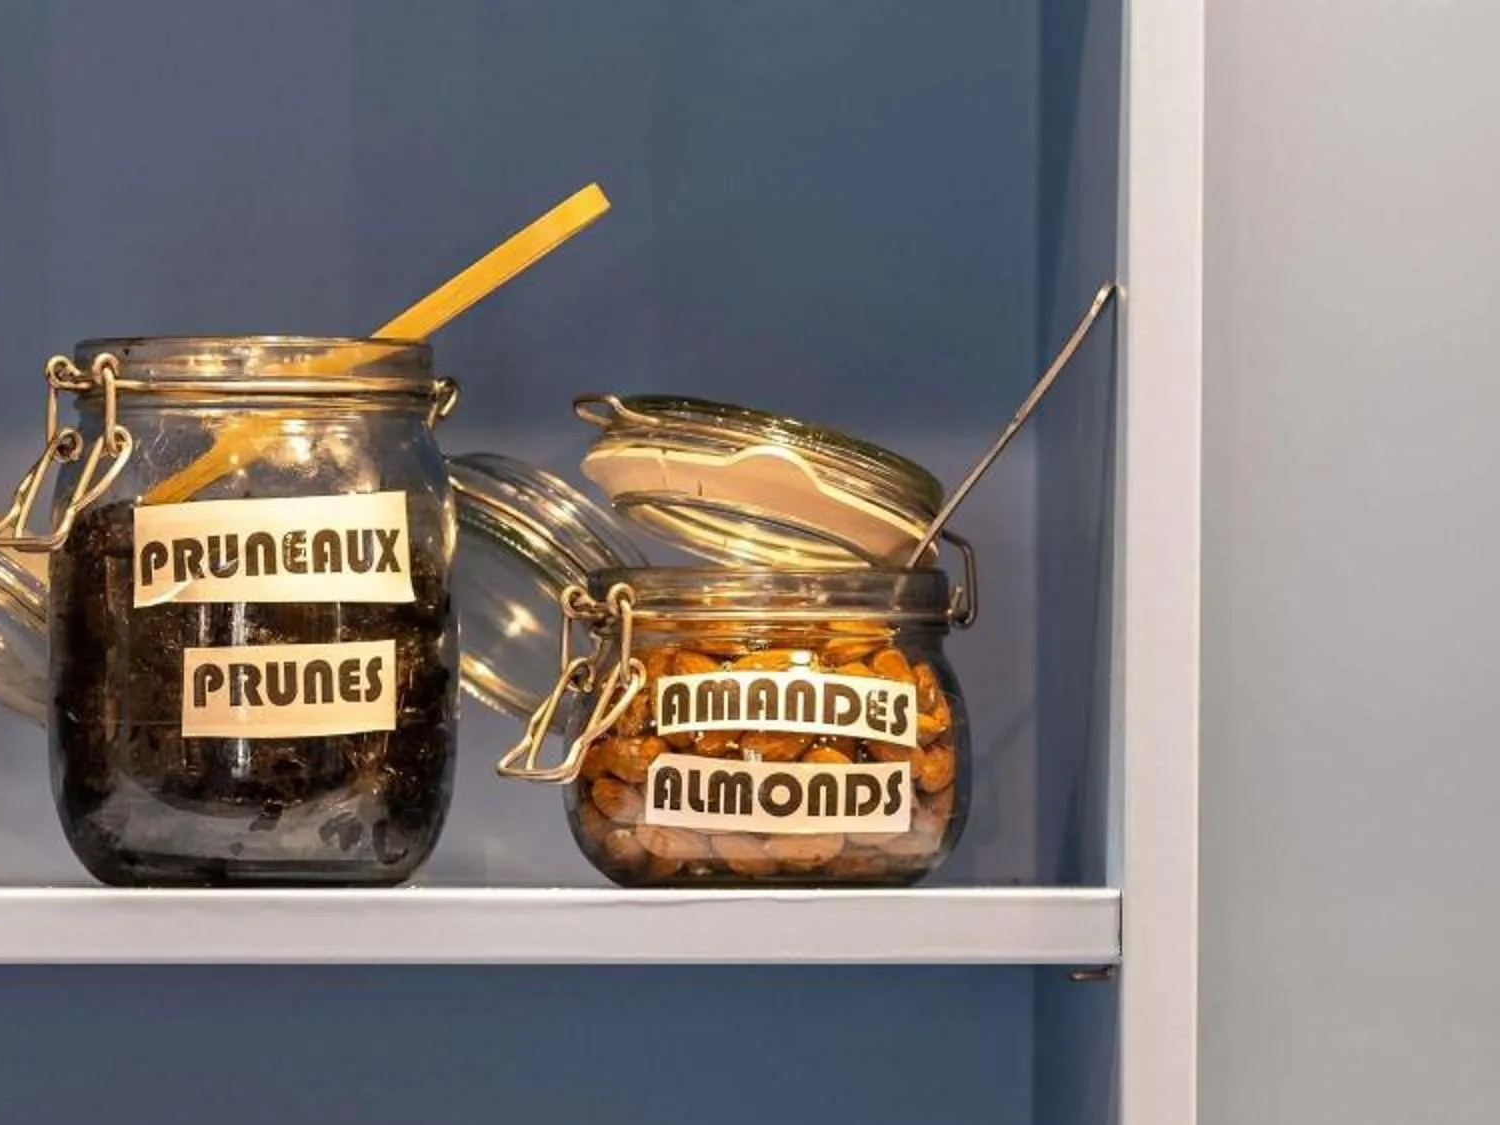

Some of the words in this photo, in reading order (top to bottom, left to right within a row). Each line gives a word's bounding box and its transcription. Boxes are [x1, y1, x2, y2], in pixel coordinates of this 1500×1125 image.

[140, 528, 402, 587] PRUNEAUX
[193, 656, 383, 708] PRUNES
[661, 677, 909, 737] AMANDES
[653, 765, 903, 818] ALMONDS
